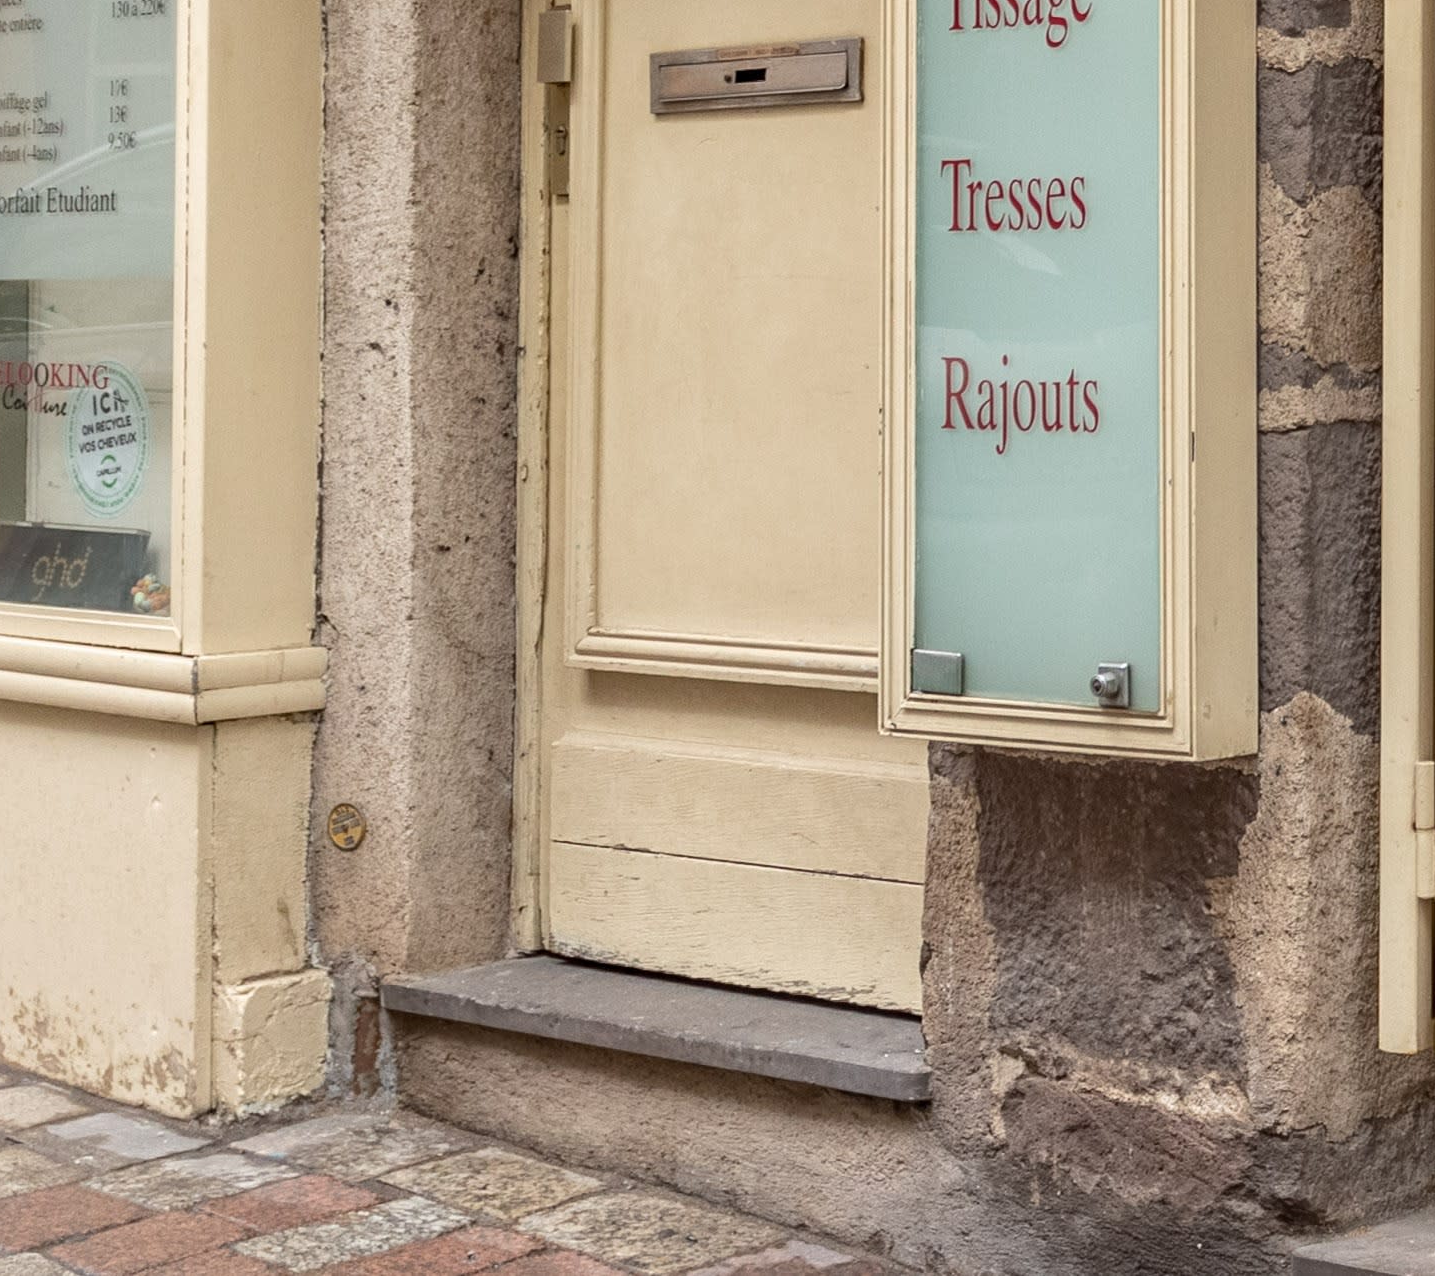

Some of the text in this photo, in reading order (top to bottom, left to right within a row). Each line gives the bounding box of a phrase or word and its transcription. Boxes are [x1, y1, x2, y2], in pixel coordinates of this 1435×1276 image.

[112, 1, 129, 18] 130
[32, 91, 48, 113] gel
[109, 105, 128, 124] 13€
[46, 185, 117, 214] Etudiant
[940, 158, 1087, 233] Tresses
[941, 353, 1101, 455] Rajouts
[81, 415, 133, 436] ON RECYCLE
[78, 432, 138, 454] VOS CHEVEUX
[32, 542, 94, 602] ghd
